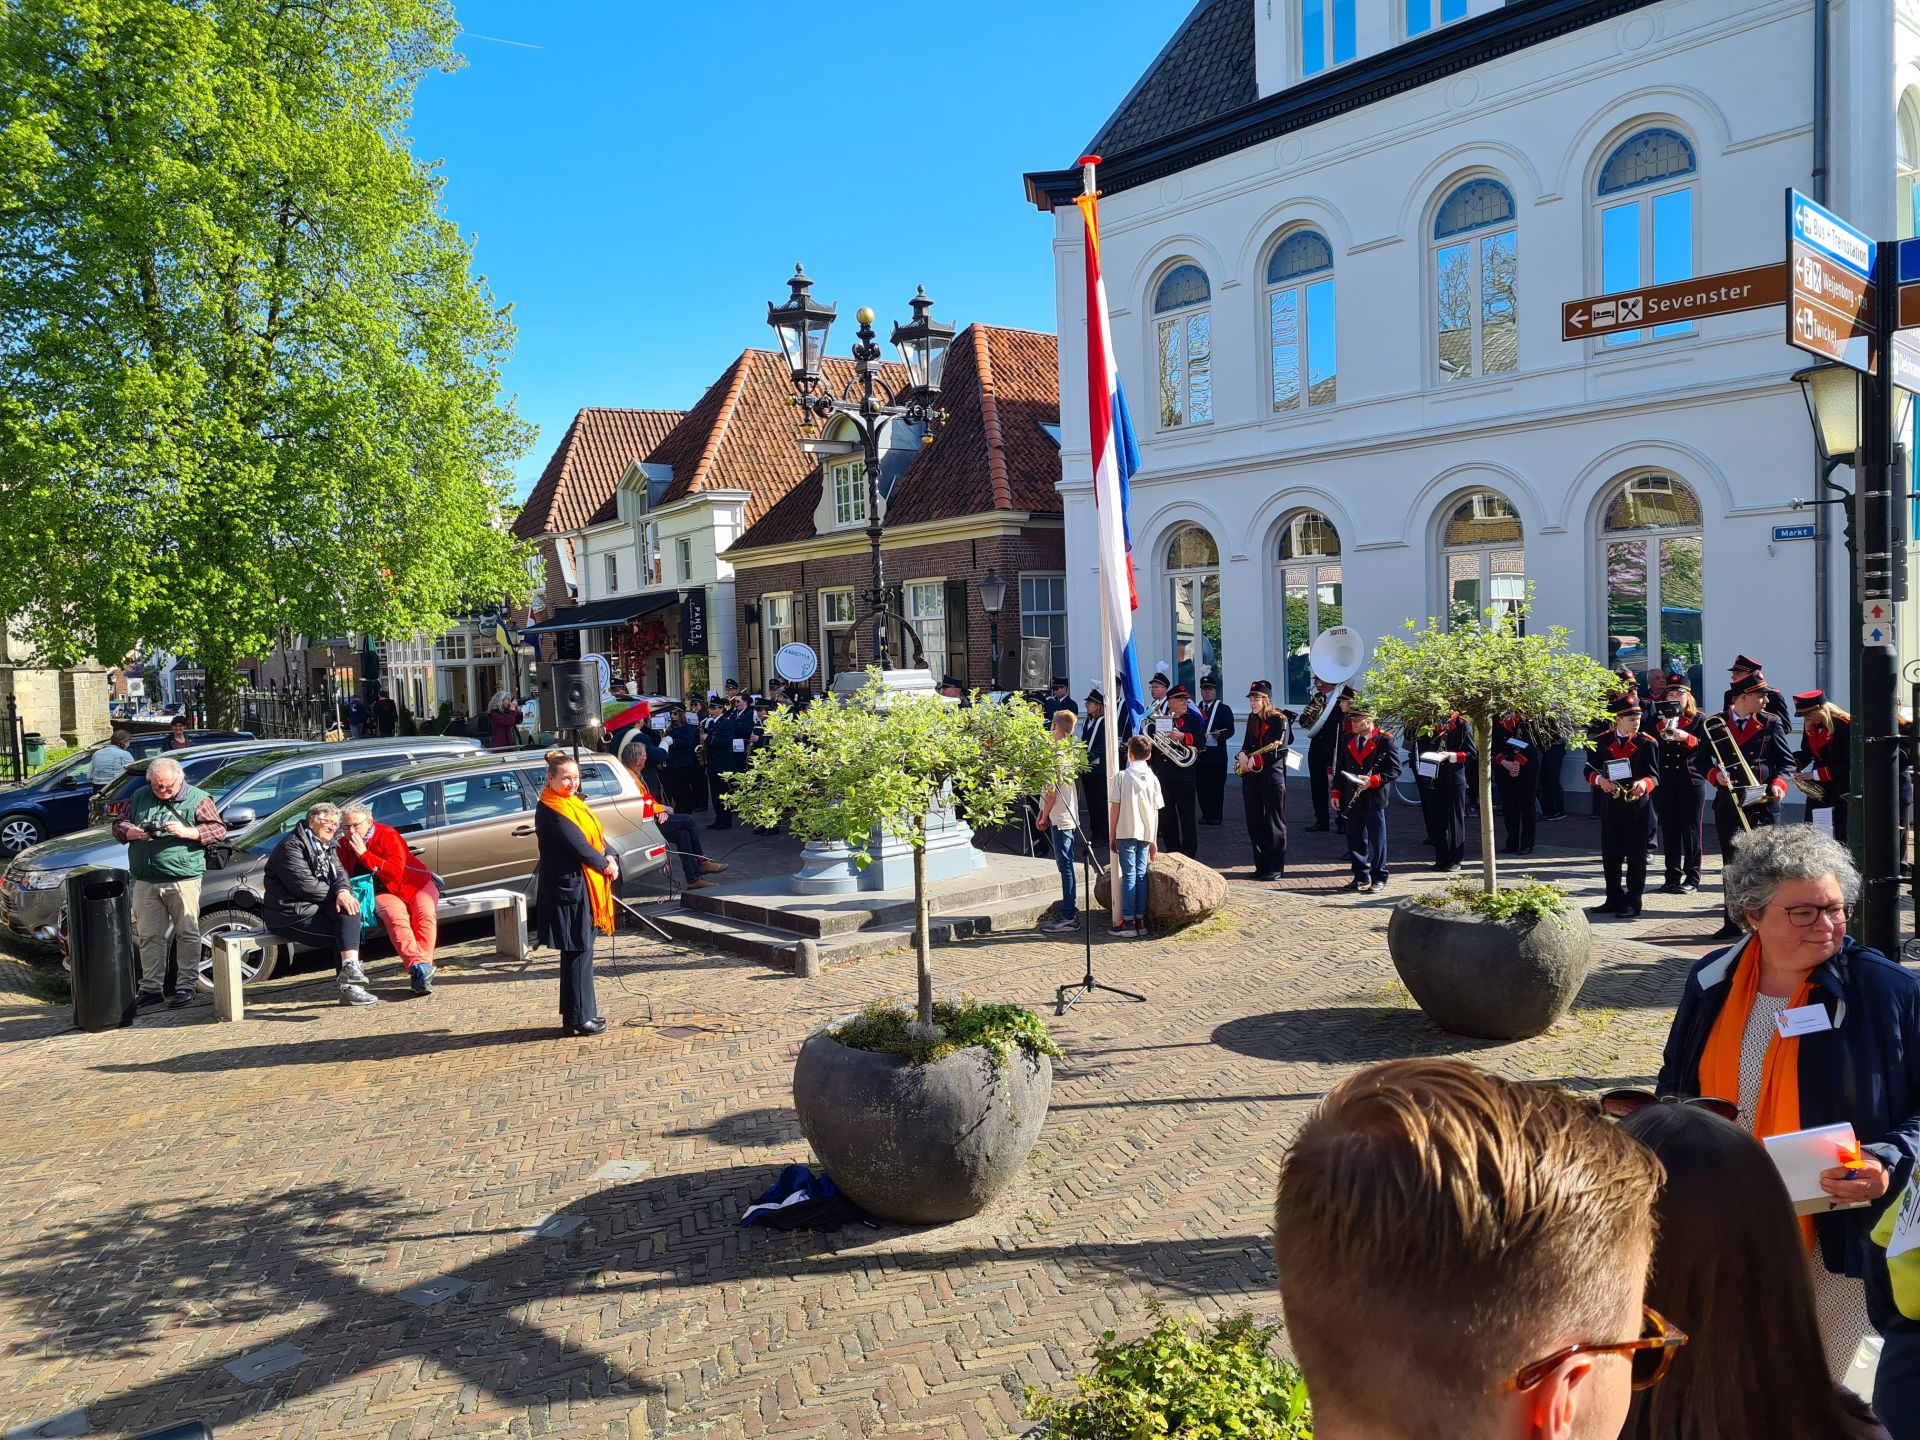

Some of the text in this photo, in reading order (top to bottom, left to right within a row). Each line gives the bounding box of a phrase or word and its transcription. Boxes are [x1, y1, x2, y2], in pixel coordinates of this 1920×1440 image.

[1813, 218, 1826, 240] Bus
[1832, 228, 1868, 265] Treinstation
[1648, 284, 1752, 314] Sevenster
[1822, 271, 1854, 308] Weijenborg
[1813, 317, 1837, 345] Twickel
[1781, 529, 1808, 537] Markt
